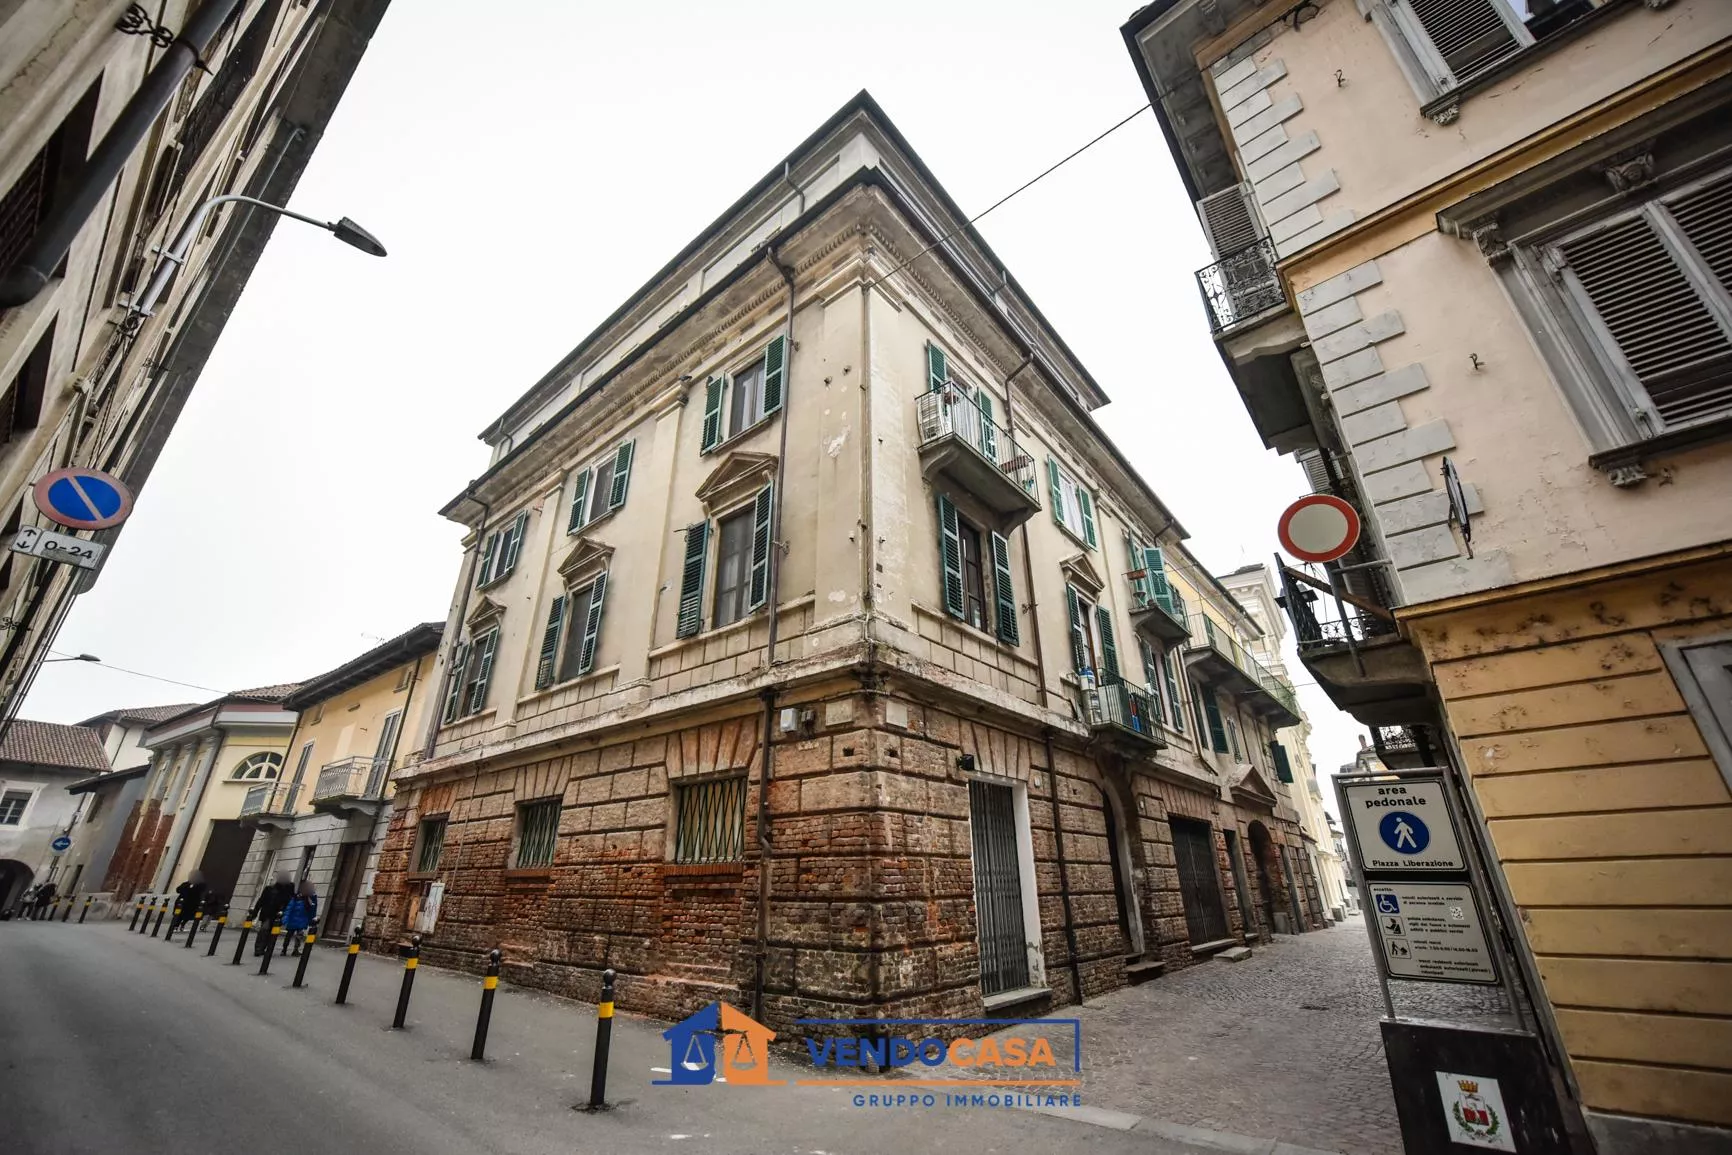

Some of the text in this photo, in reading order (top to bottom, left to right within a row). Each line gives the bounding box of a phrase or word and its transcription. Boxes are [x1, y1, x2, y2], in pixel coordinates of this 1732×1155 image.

[44, 540, 93, 559] 0-24
[1377, 786, 1407, 795] area
[1365, 796, 1427, 808] pedonale
